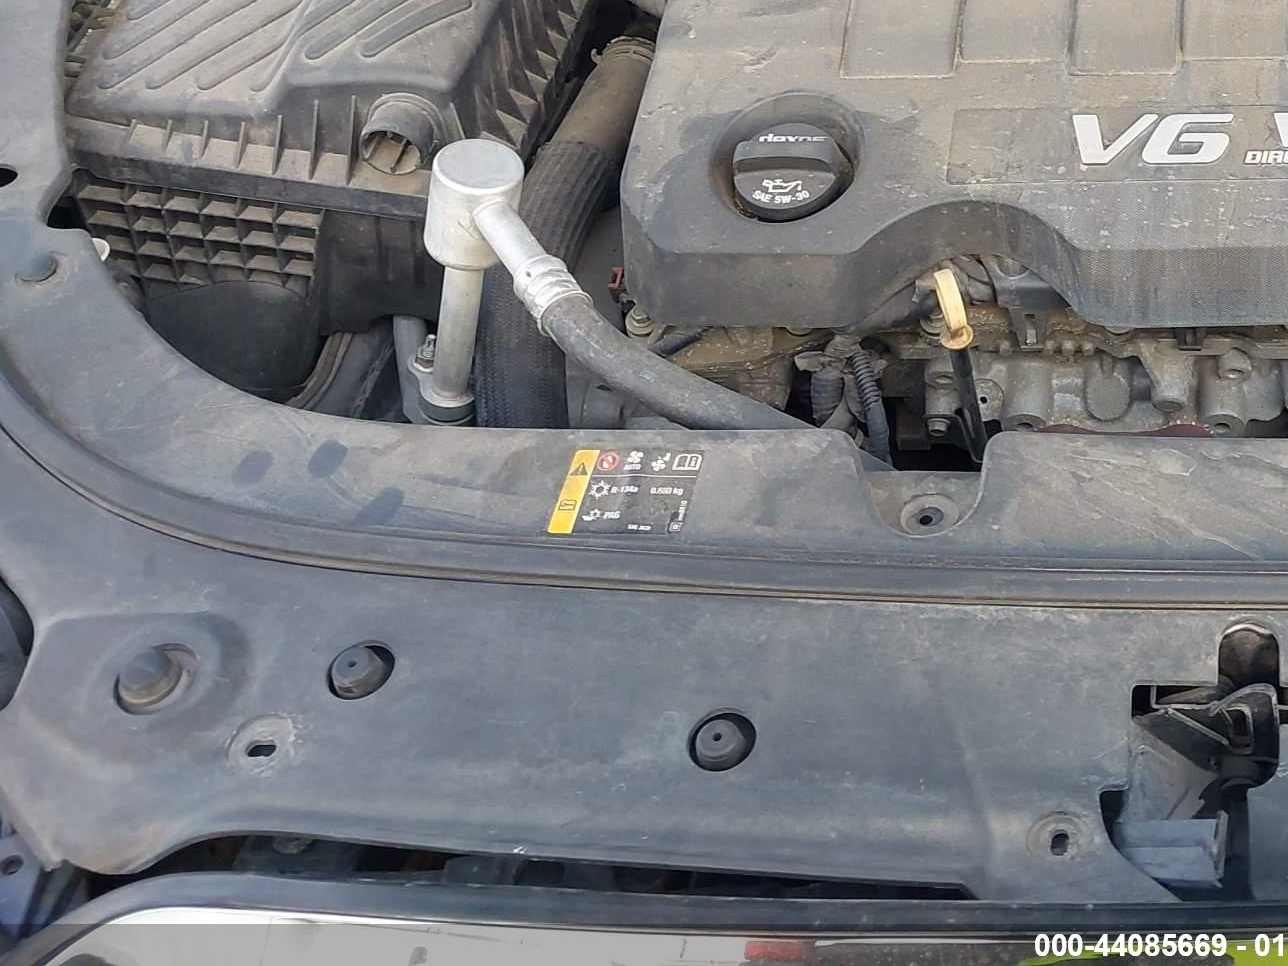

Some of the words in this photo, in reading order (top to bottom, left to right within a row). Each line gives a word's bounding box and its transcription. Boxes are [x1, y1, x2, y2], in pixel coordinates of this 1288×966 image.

[1072, 113, 1235, 165] V6
[752, 189, 771, 203] SAE
[773, 189, 810, 204] 5W-30
